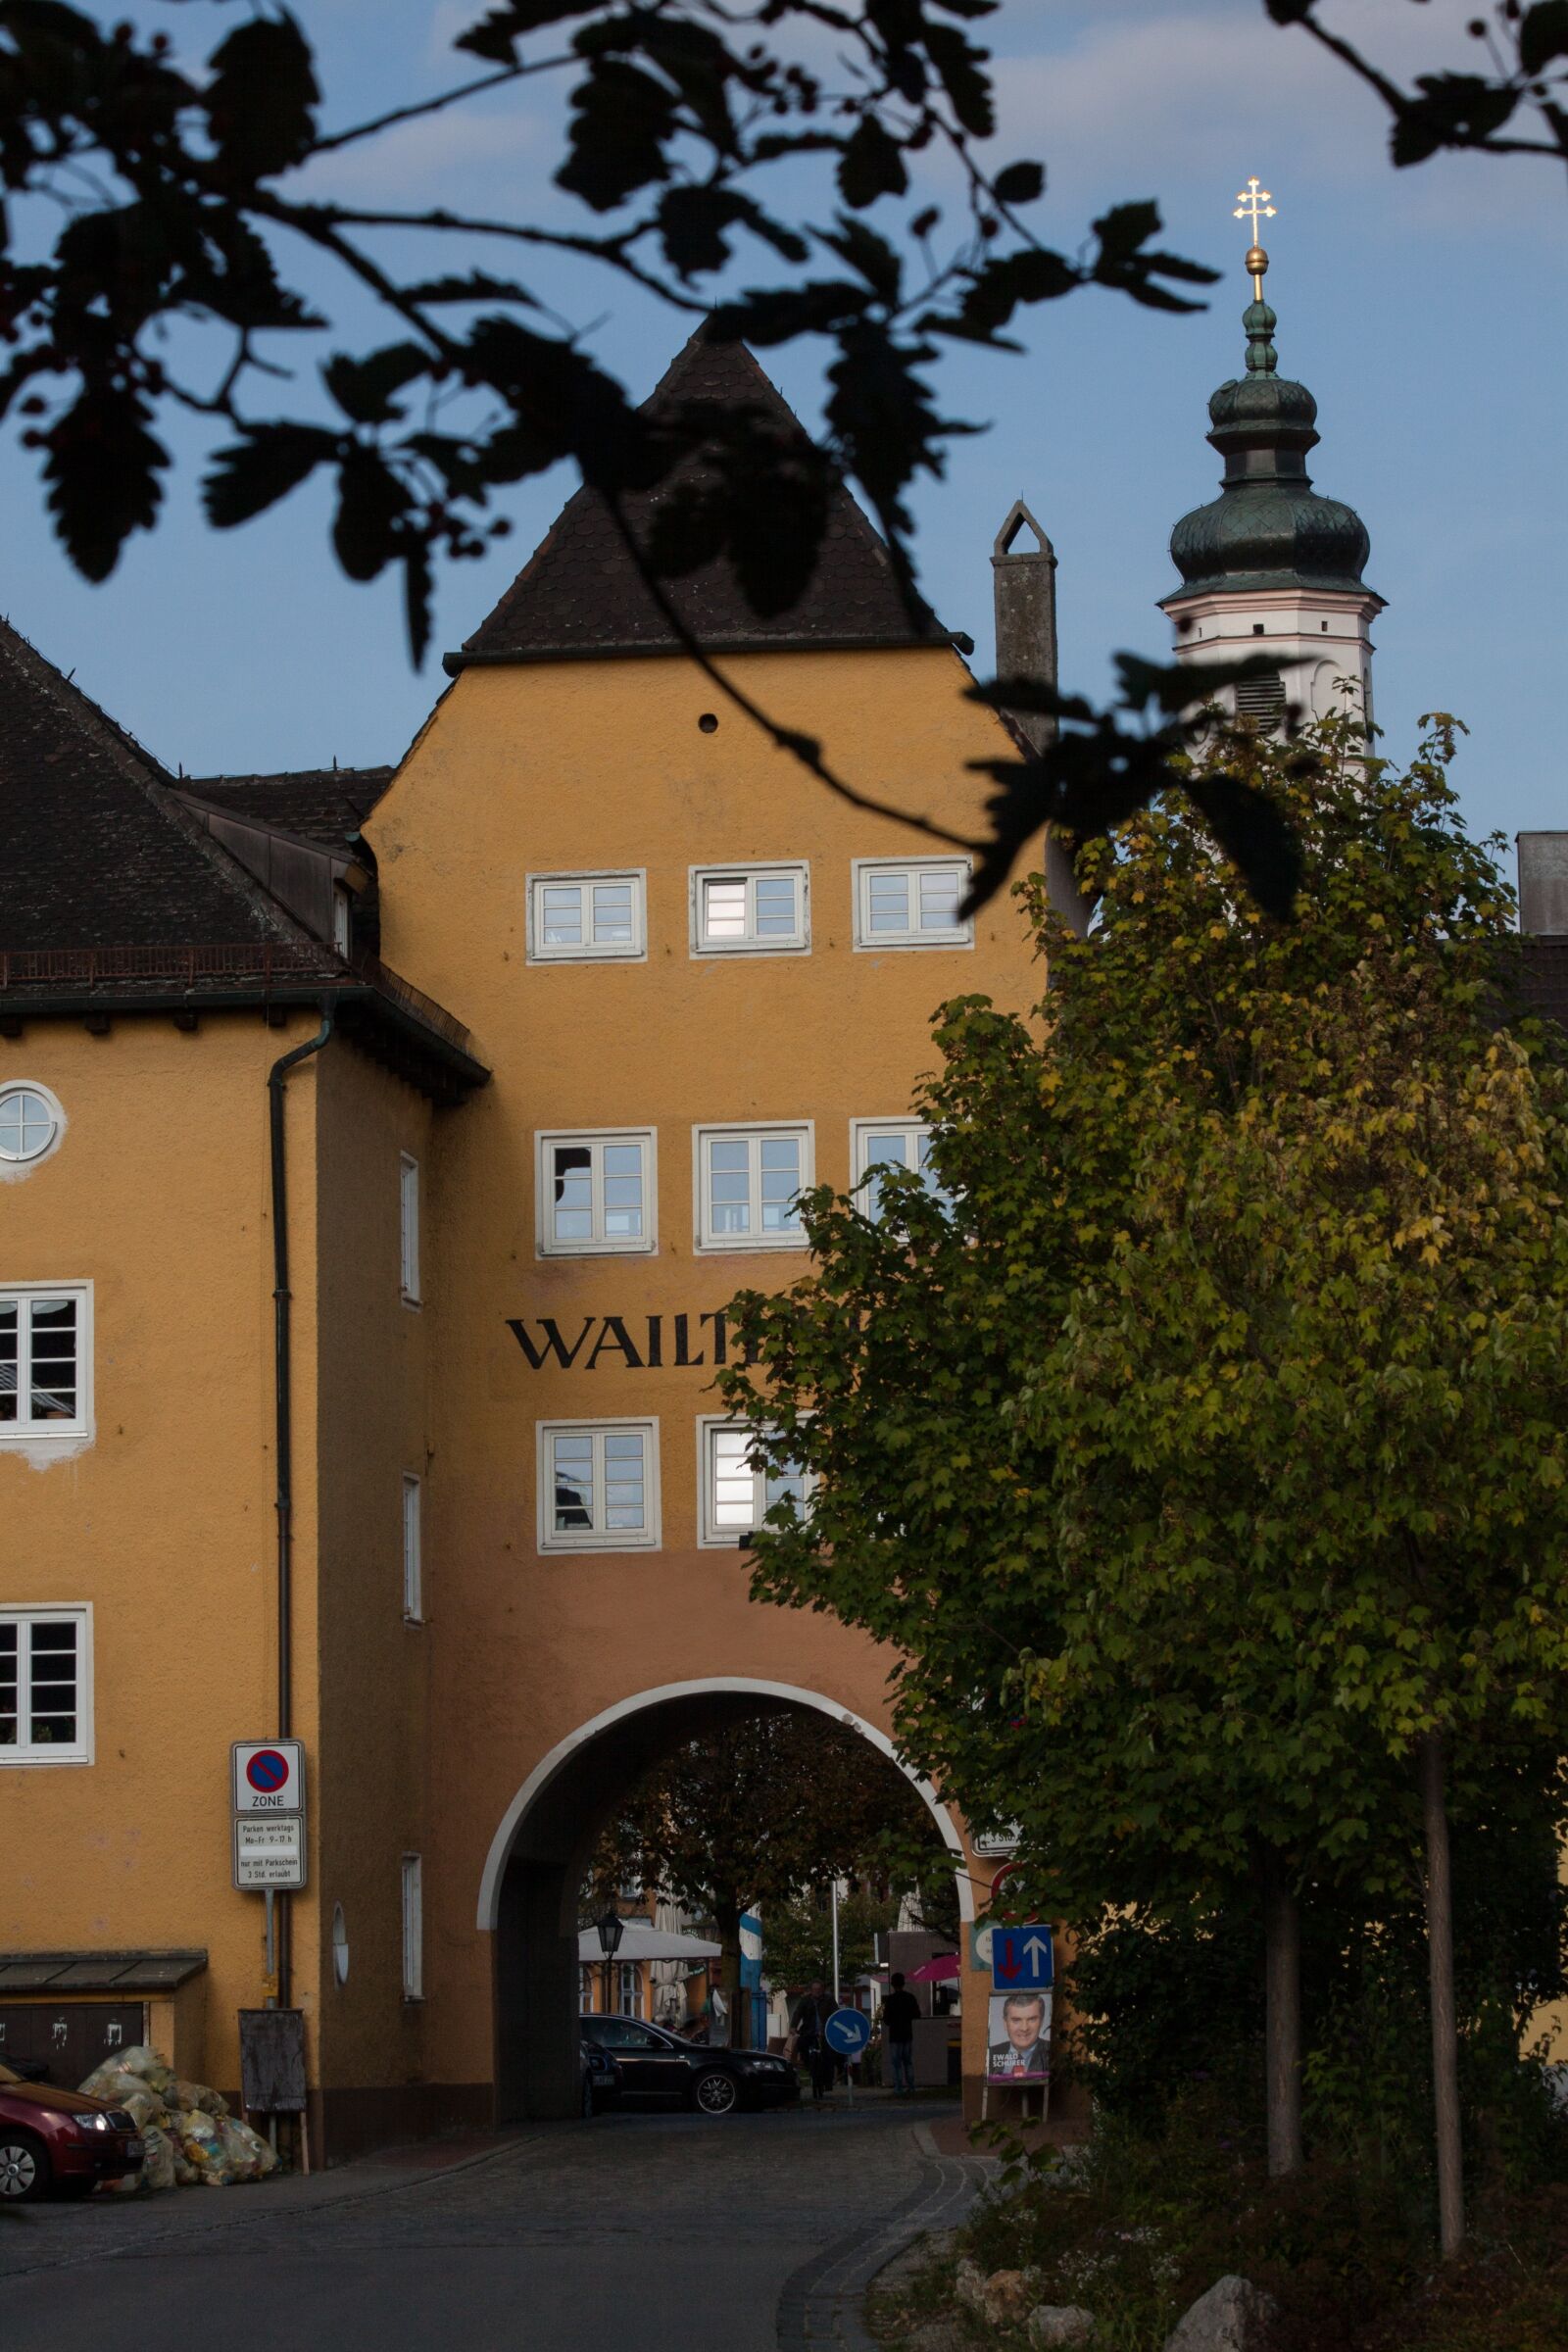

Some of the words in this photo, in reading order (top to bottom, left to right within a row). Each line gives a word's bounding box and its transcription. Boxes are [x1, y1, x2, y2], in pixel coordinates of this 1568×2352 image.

[252, 1795, 284, 1807] ZONE
[242, 1825, 265, 1834] Parken
[267, 1825, 294, 1834] werktags
[240, 1859, 252, 1868] nur
[253, 1858, 264, 1867] mit
[265, 1857, 298, 1867] Parkschein
[269, 1869, 291, 1878] erlaubt
